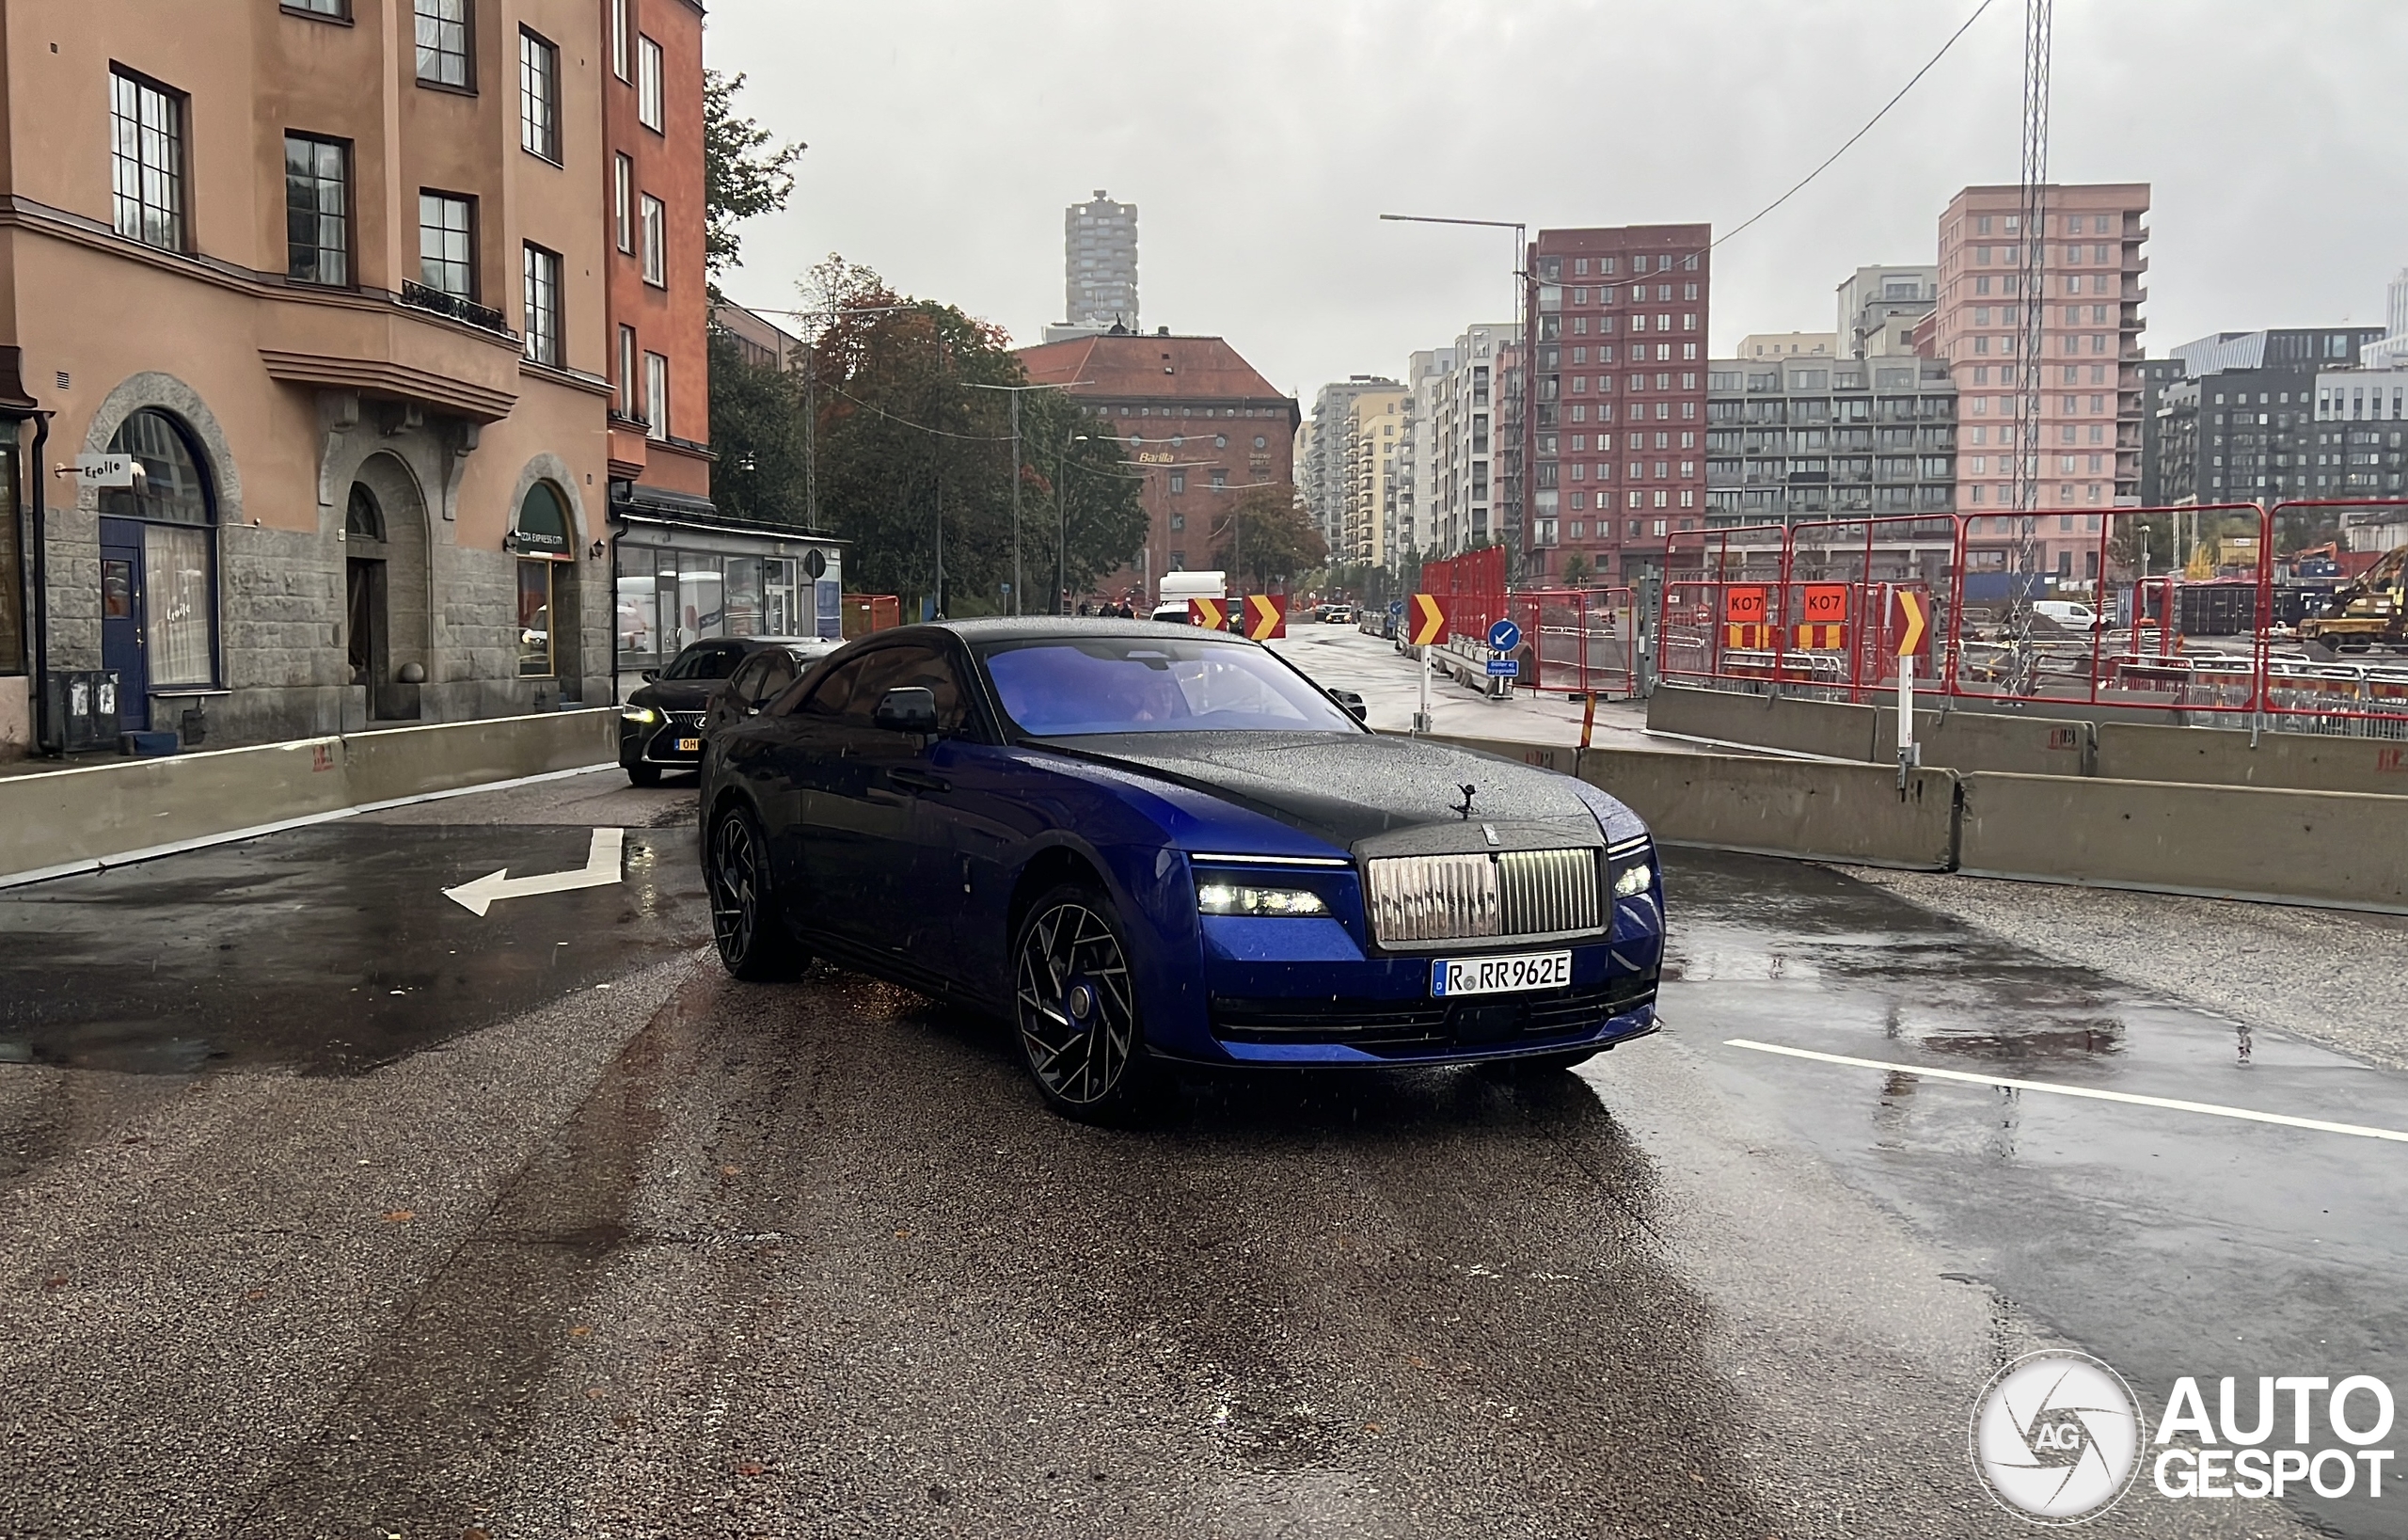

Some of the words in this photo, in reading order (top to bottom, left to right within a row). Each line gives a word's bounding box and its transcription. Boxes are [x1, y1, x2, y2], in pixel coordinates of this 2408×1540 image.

[1139, 452, 1174, 463] Barilla
[531, 532, 553, 545] EXPRESS
[553, 535, 562, 545] CITY
